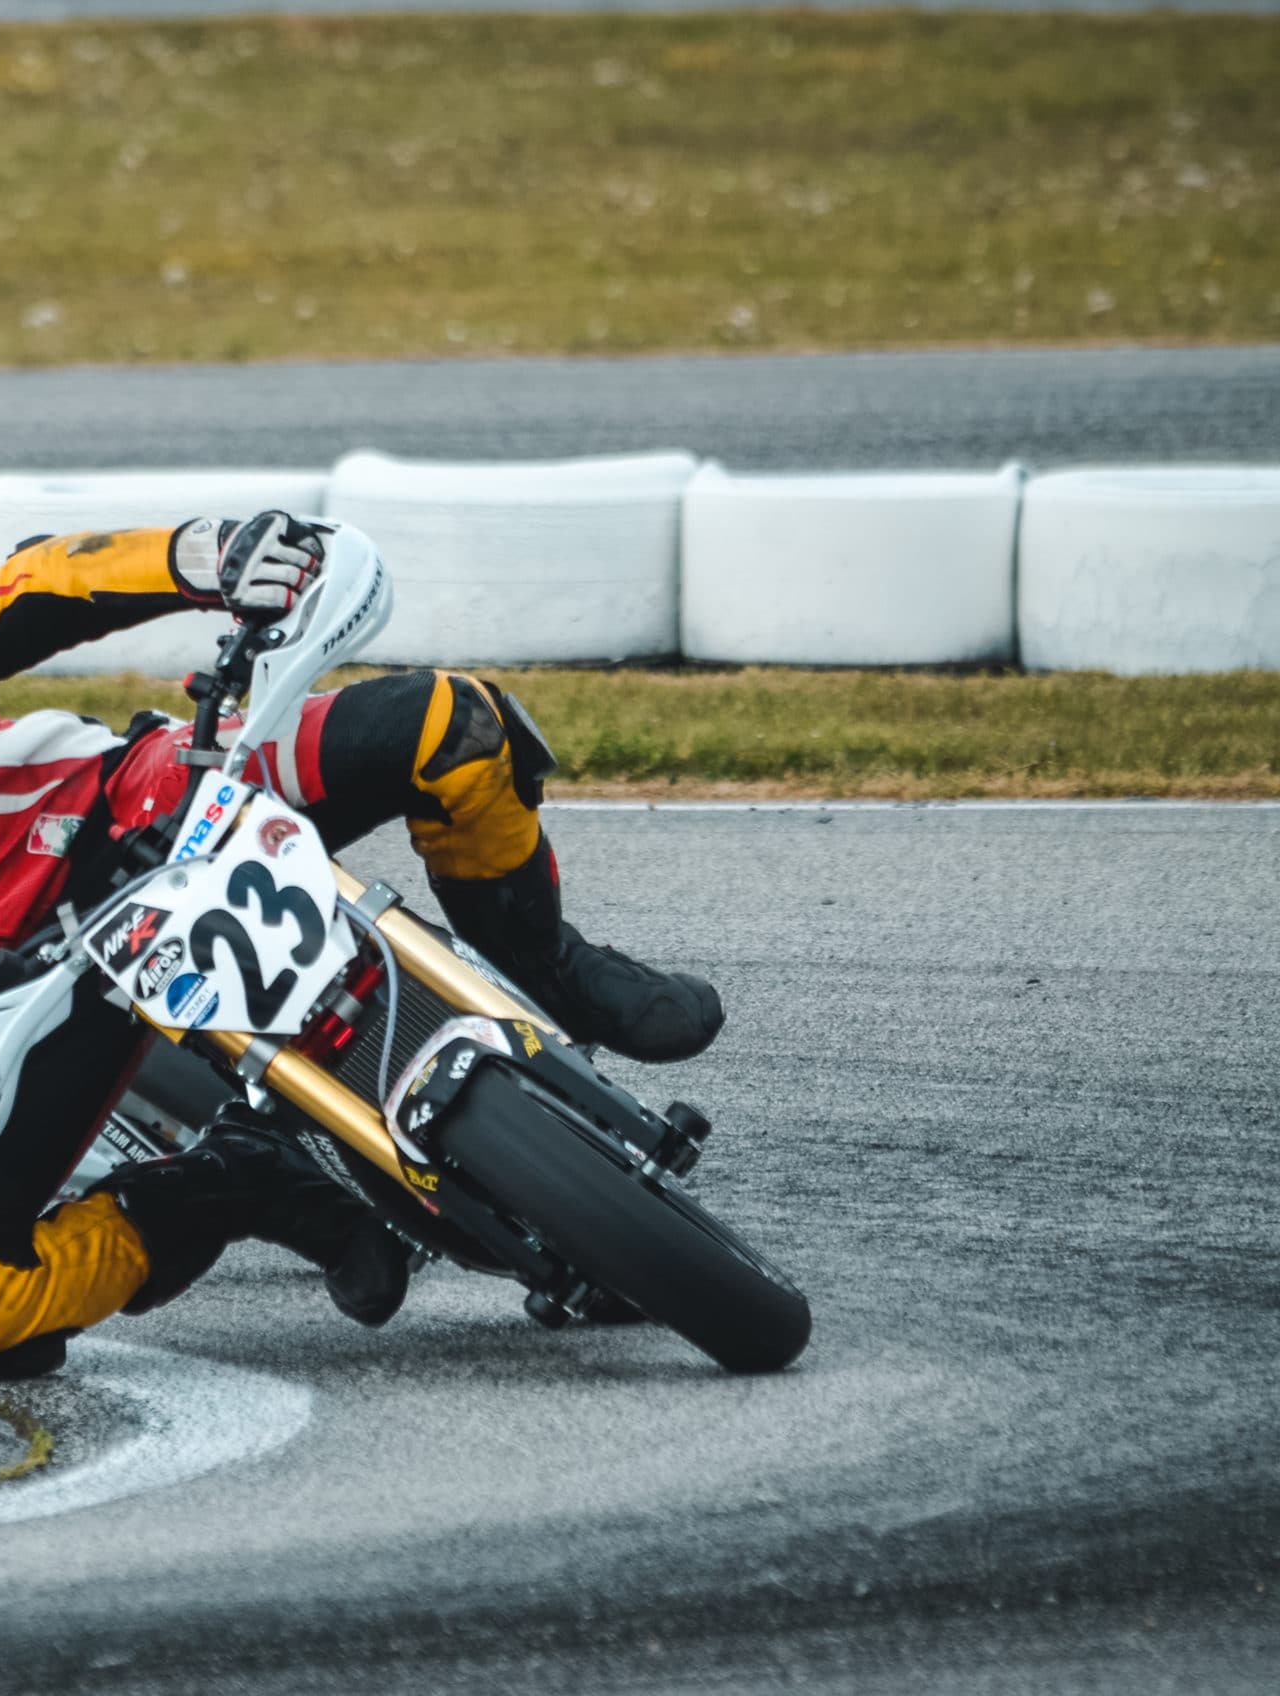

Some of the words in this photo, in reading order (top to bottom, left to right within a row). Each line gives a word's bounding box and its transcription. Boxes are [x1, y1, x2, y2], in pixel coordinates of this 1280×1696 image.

[175, 785, 235, 862] mase
[138, 943, 182, 999] Airoh
[189, 860, 326, 1030] 23
